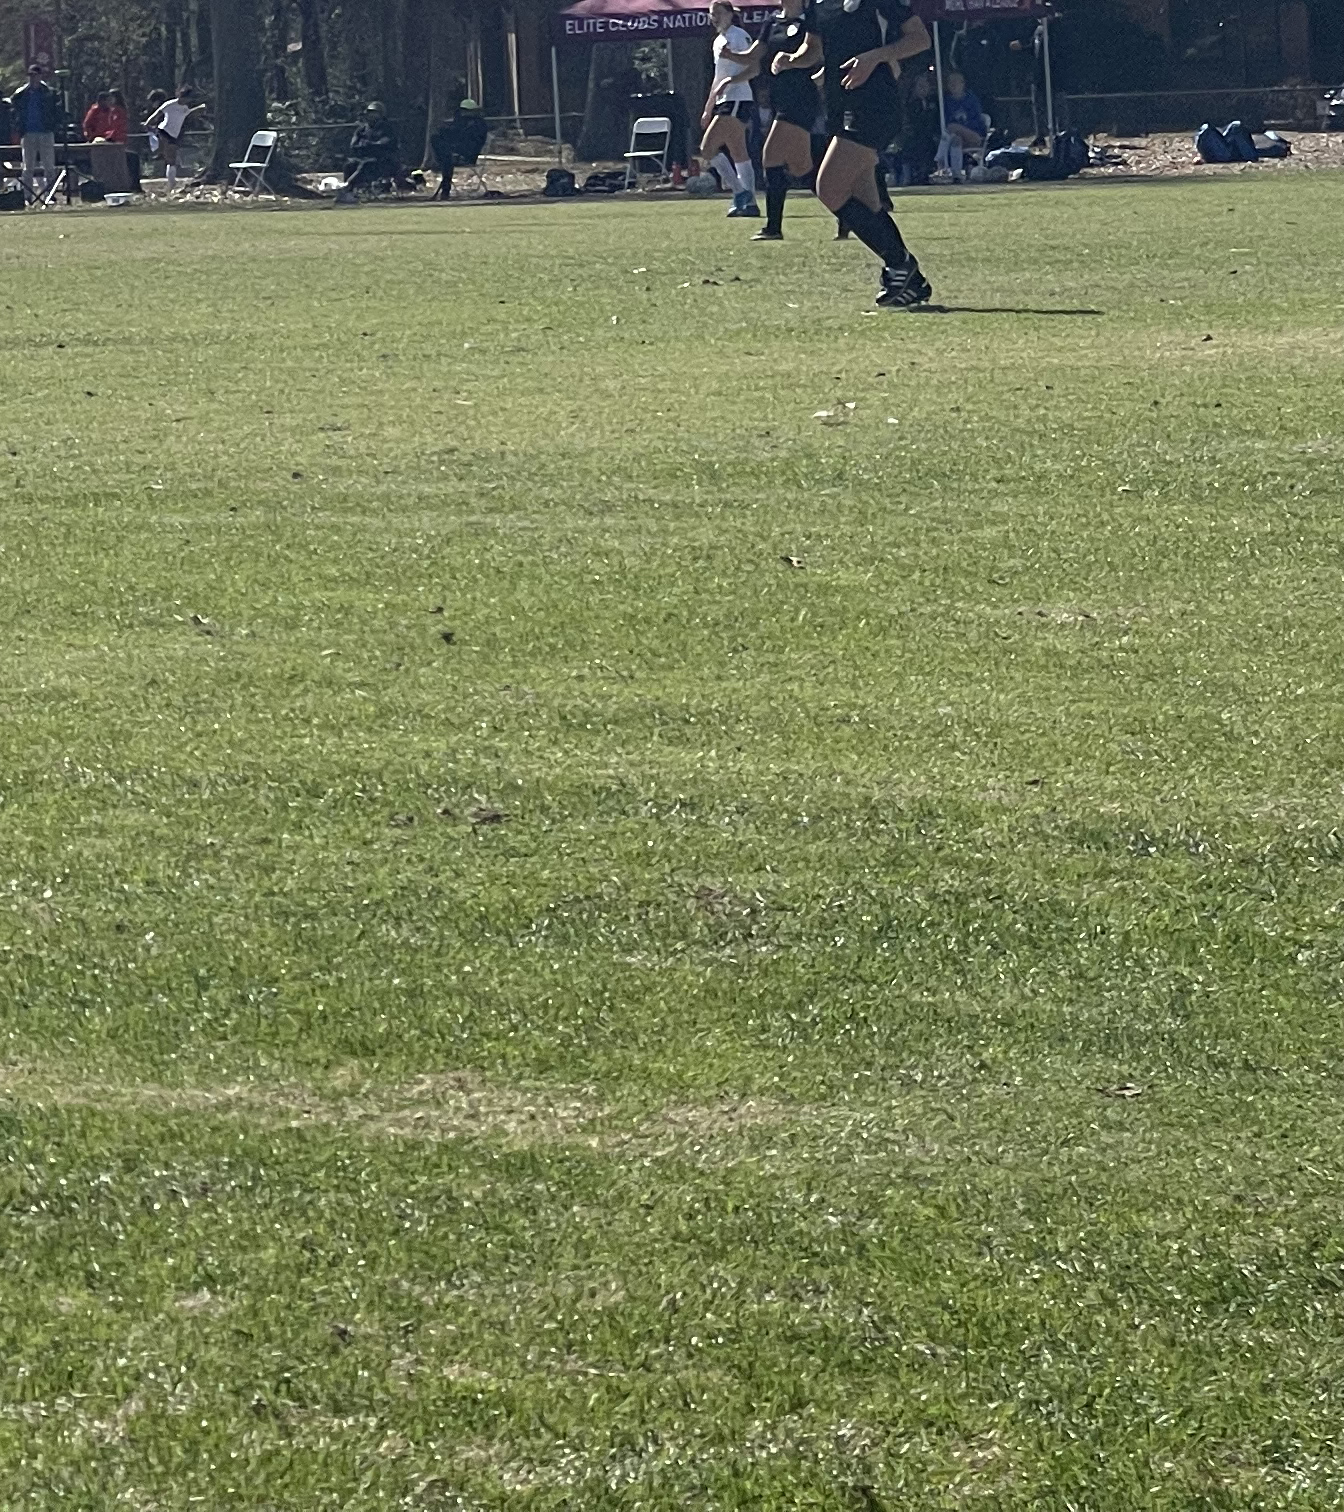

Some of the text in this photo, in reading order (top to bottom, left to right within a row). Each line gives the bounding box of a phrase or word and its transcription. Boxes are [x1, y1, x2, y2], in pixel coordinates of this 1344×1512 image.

[566, 19, 604, 34] ELITE
[609, 15, 658, 31] CLUBS
[663, 12, 712, 28] NATIO
